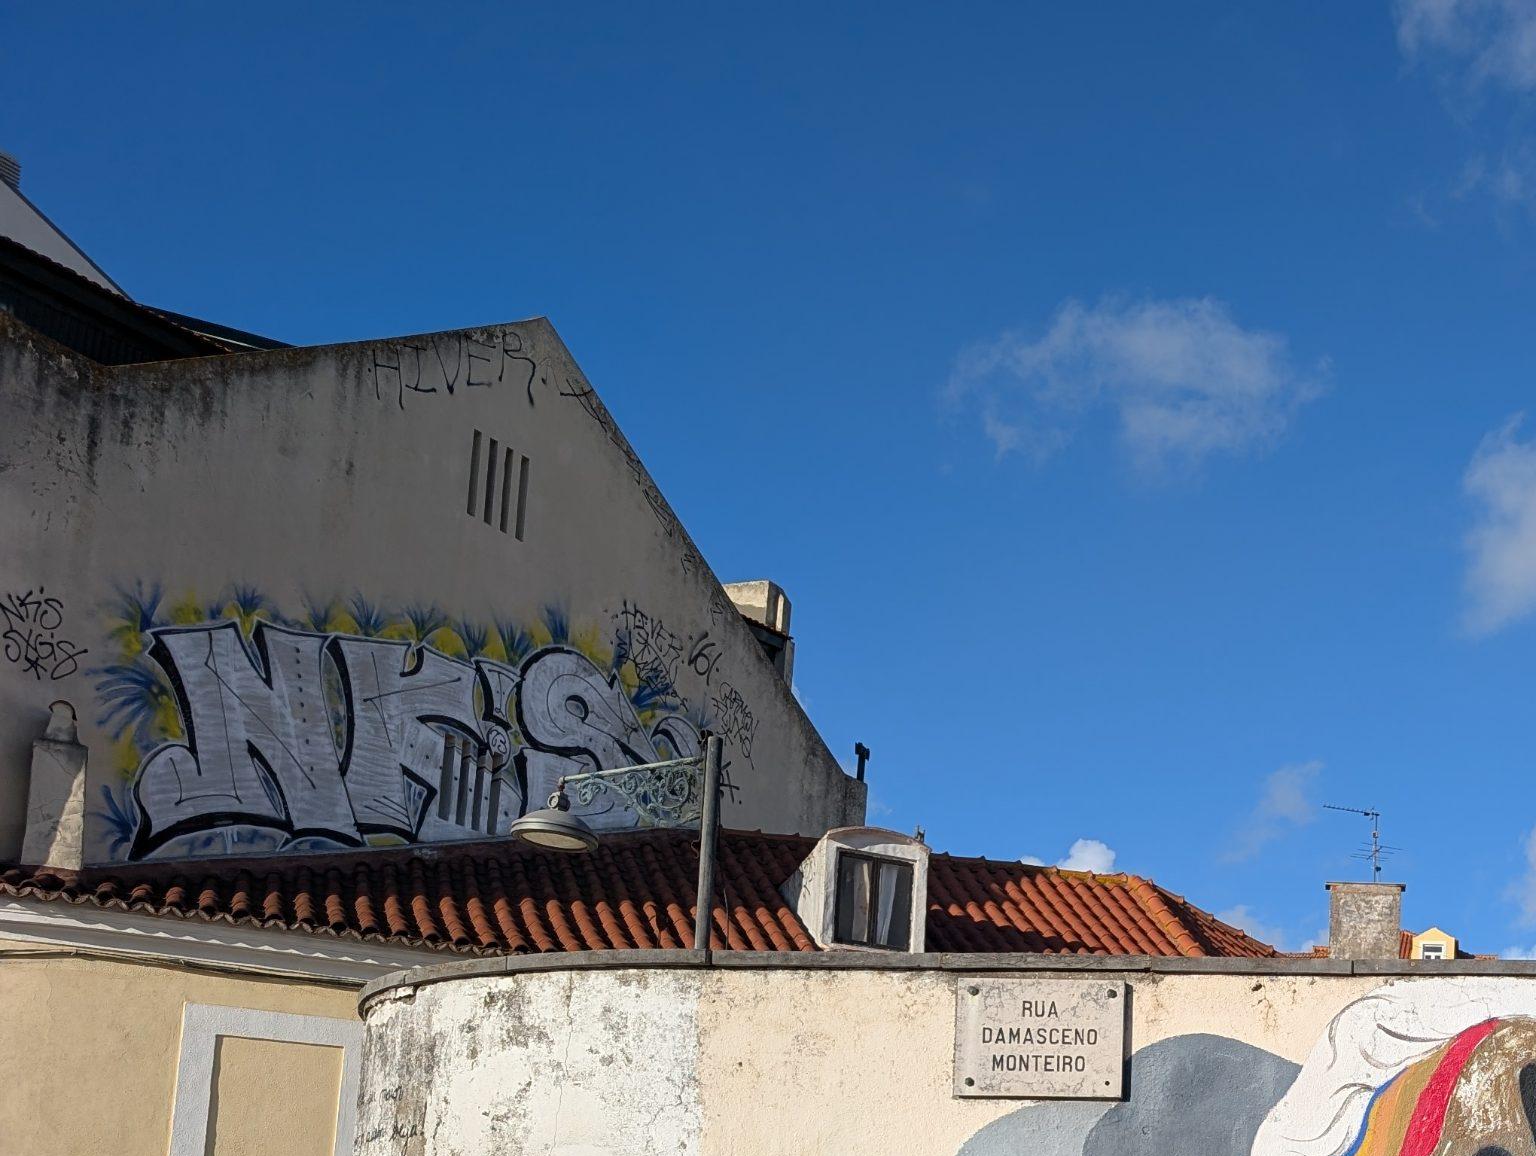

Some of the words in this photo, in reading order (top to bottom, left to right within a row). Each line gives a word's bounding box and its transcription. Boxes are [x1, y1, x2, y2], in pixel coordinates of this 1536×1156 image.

[1022, 1000, 1059, 1018] RUA
[982, 1027, 1098, 1045] DAMASCENO
[991, 1054, 1086, 1072] MONTEIRO
